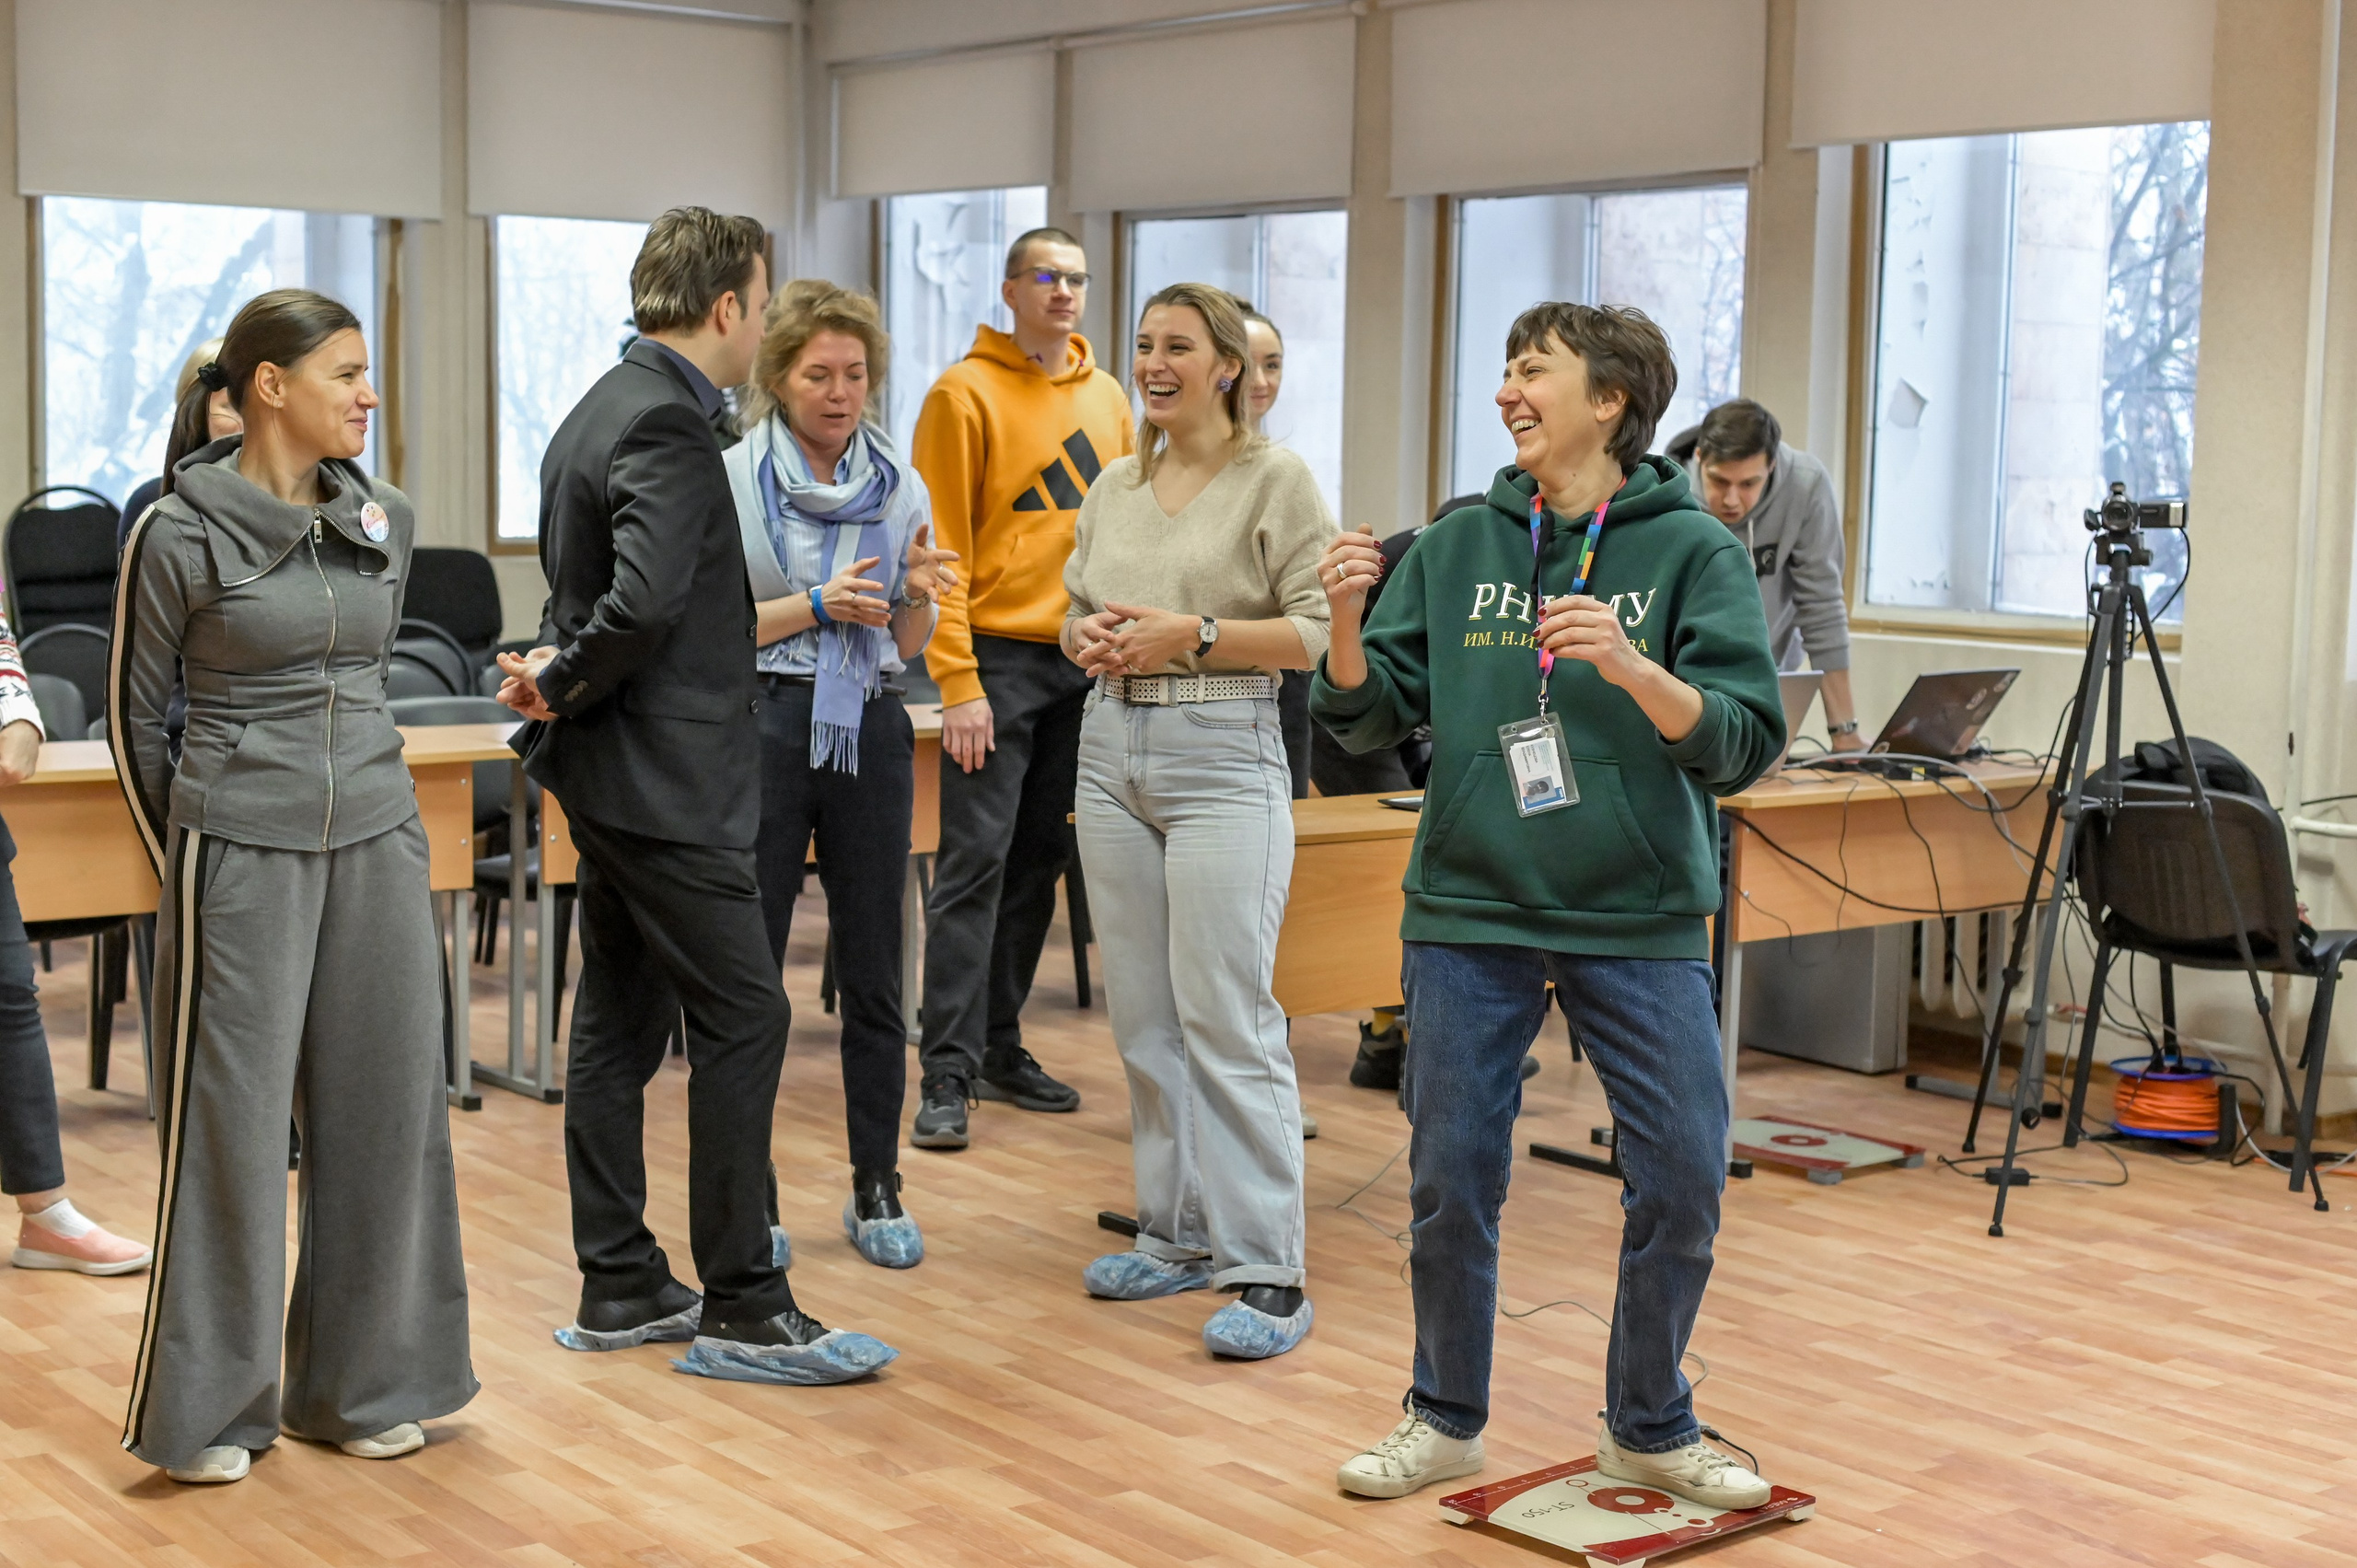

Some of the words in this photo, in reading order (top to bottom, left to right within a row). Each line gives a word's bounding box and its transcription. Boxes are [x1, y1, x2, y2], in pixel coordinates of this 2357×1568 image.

[1469, 582, 1656, 627] РНУ
[1463, 632, 1494, 647] ИМ.
[1522, 1501, 1575, 1518] ST-150
